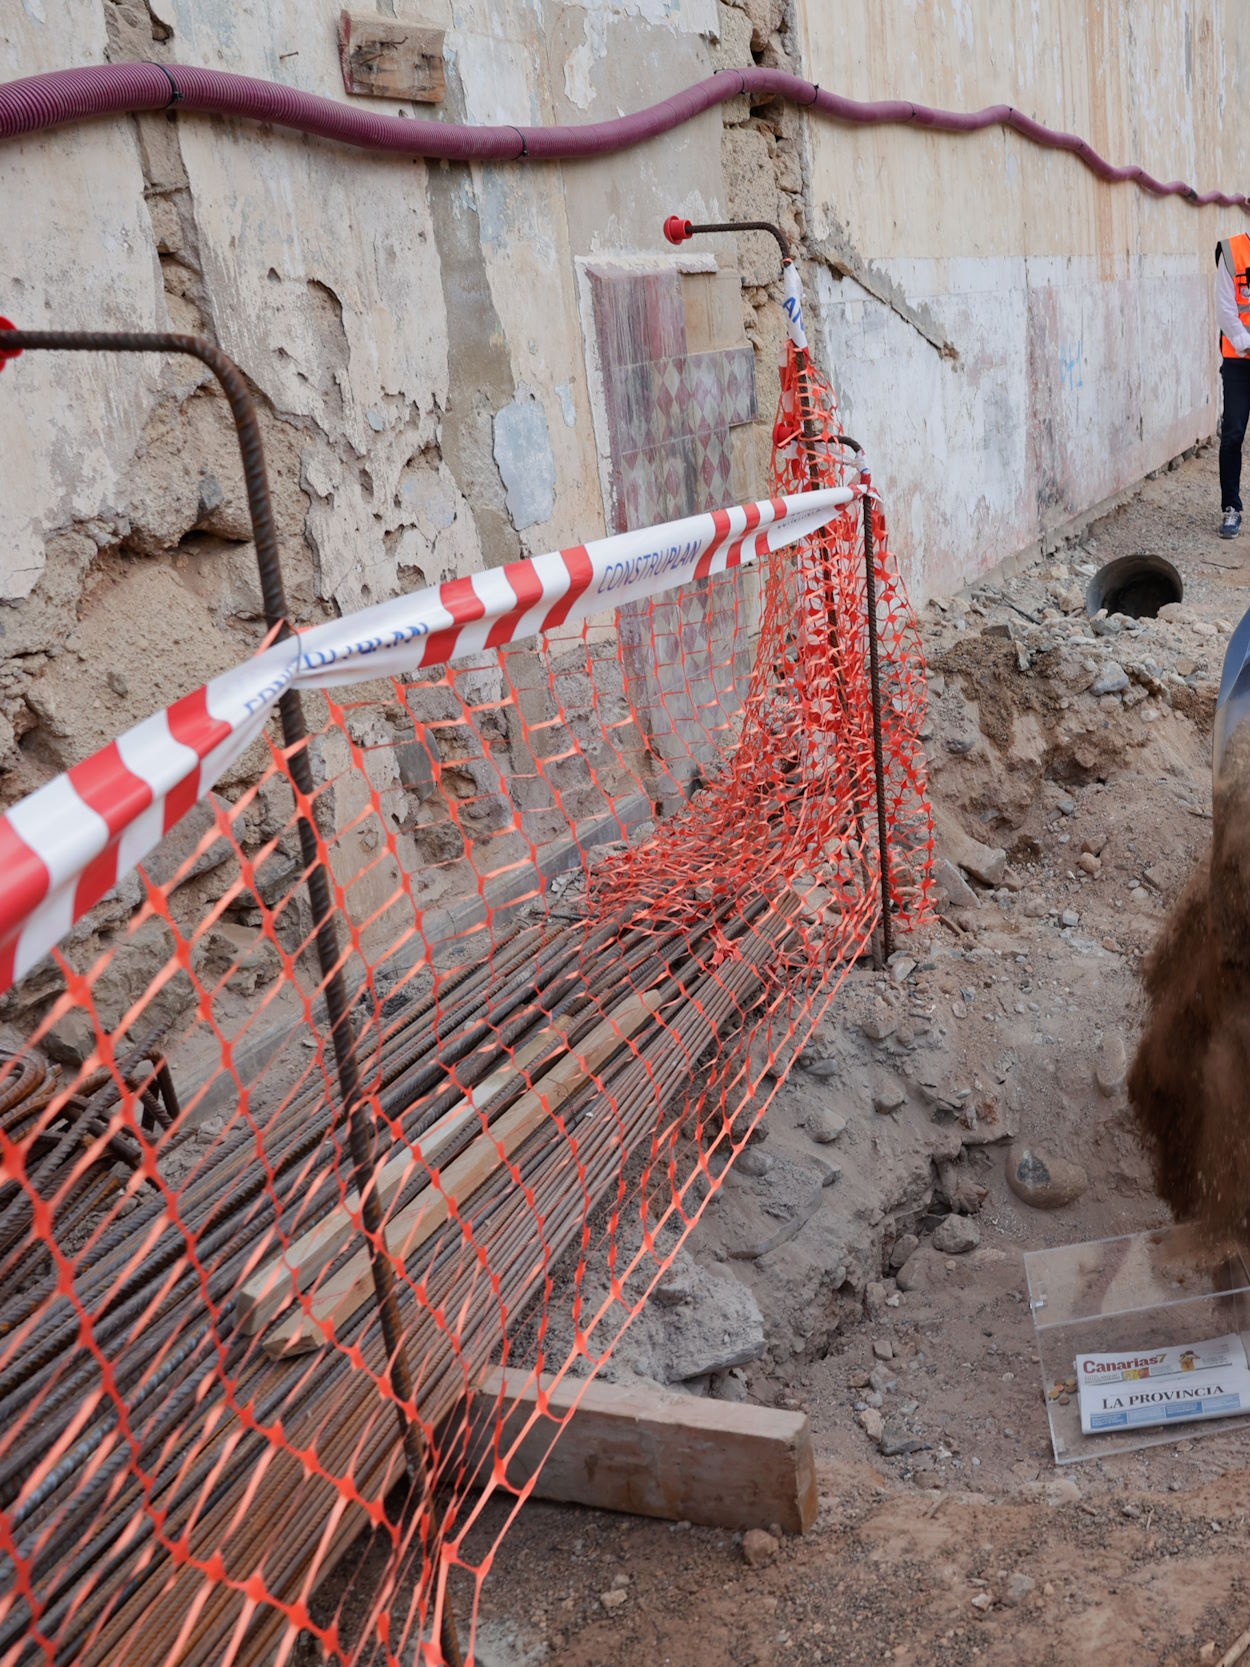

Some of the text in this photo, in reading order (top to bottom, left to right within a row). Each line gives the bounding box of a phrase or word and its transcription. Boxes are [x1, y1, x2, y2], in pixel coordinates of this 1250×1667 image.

[597, 539, 703, 595] CONSTRUPLAN
[1083, 1353, 1168, 1374] Canarias7
[1102, 1397, 1124, 1410] LA
[1129, 1385, 1225, 1406] PROVINCIA
